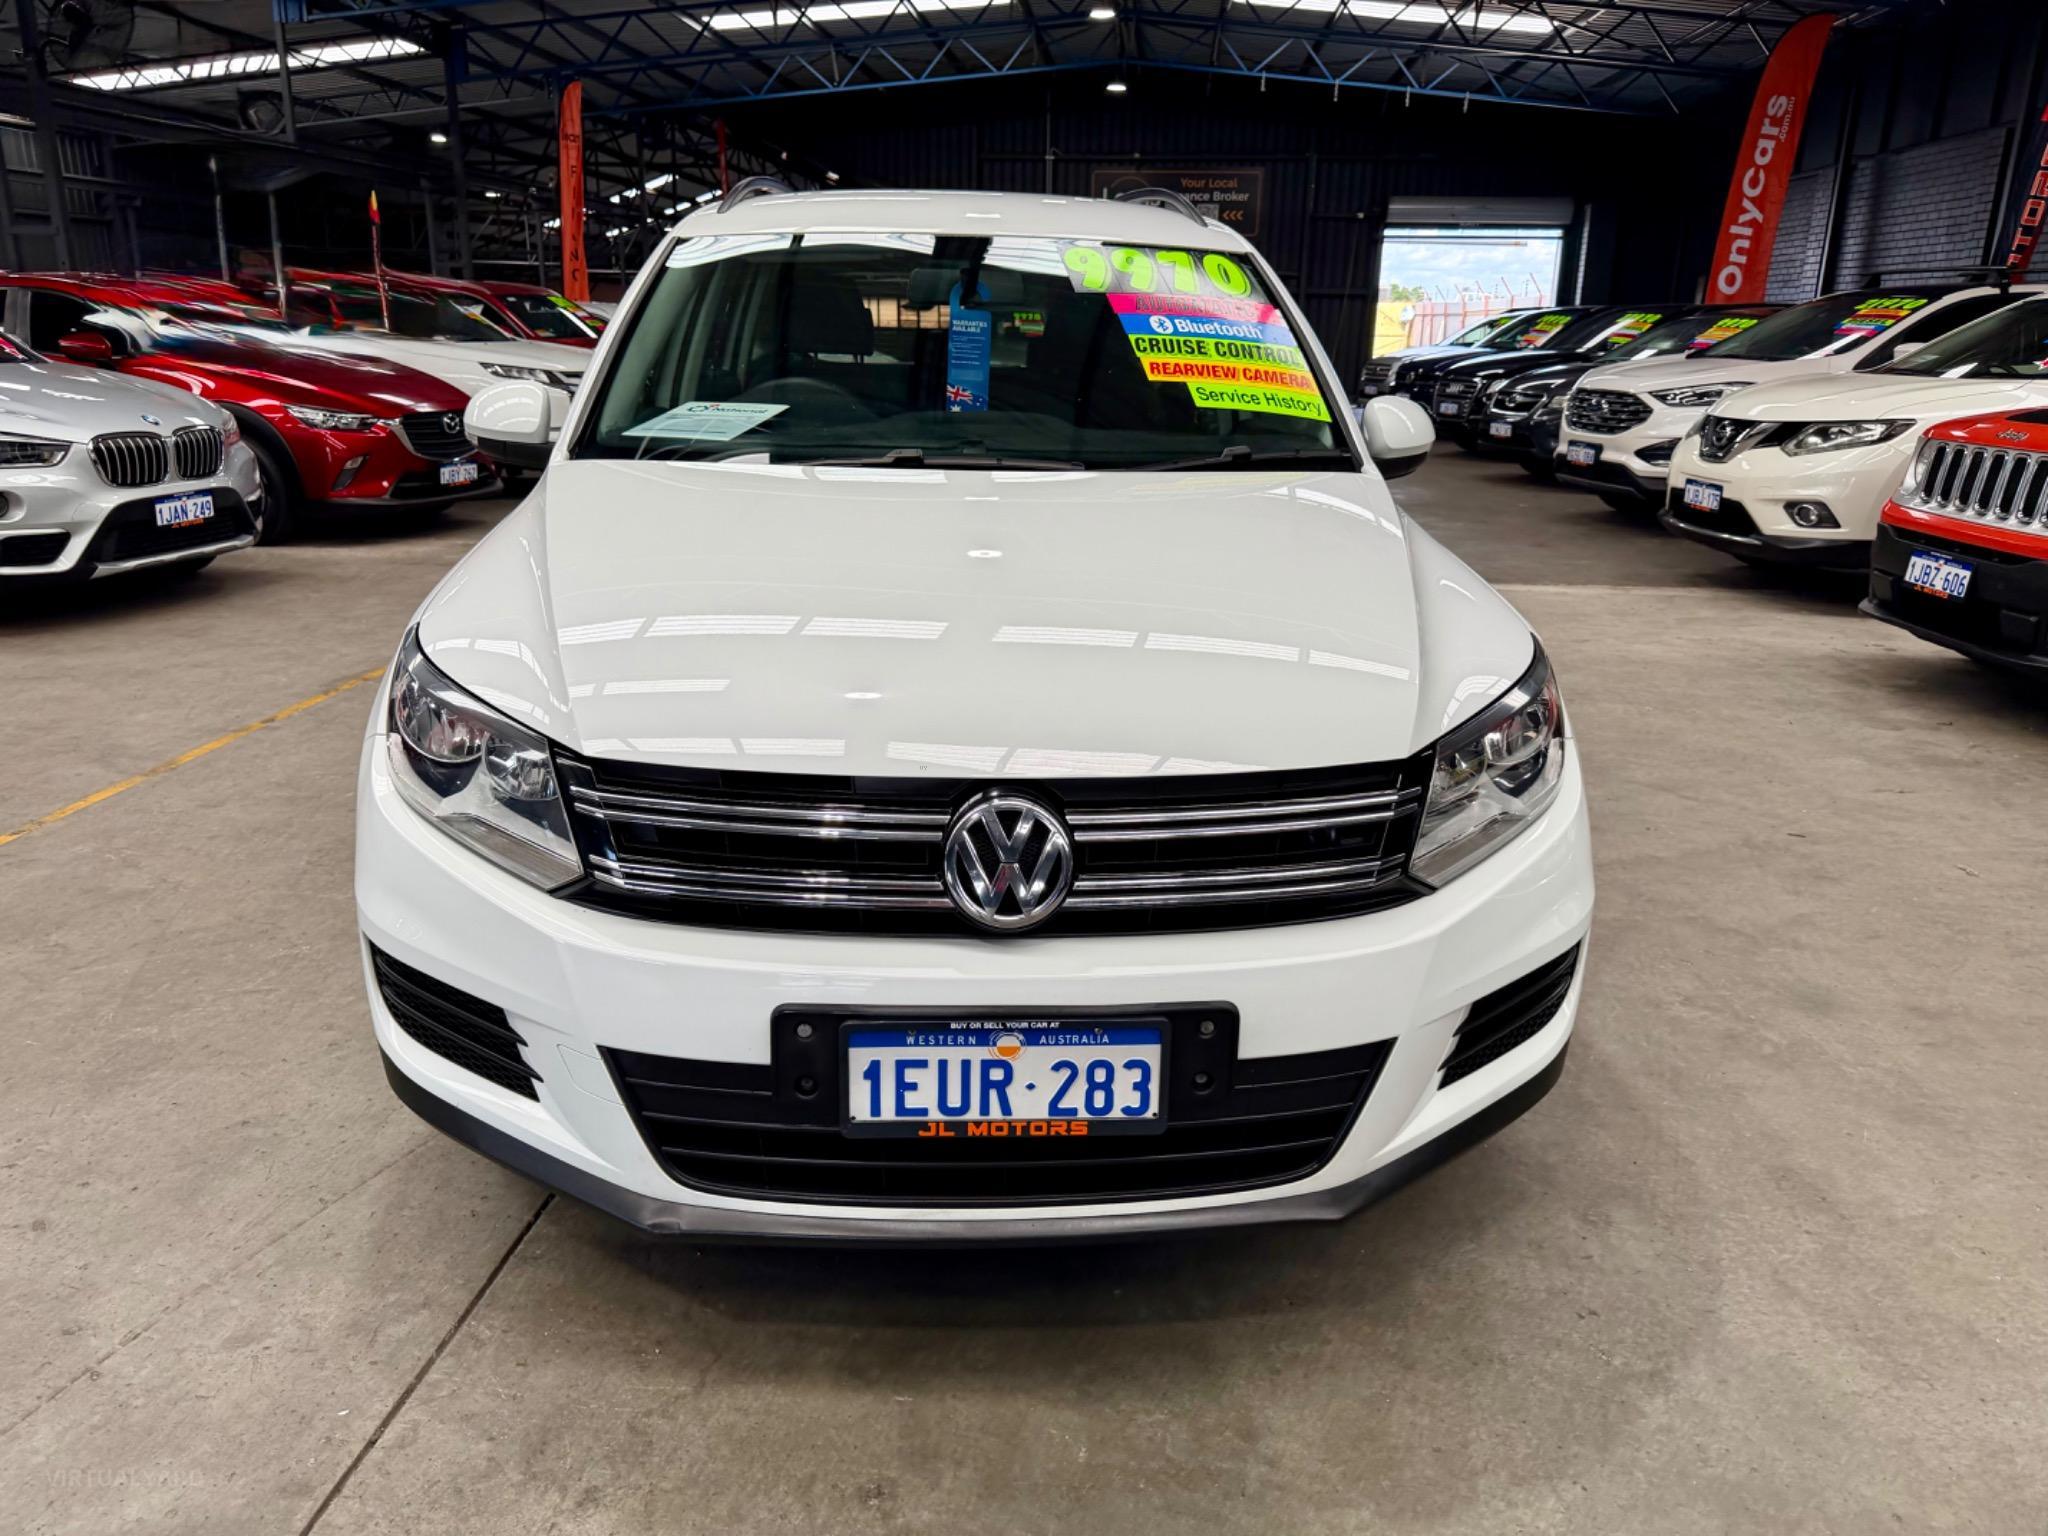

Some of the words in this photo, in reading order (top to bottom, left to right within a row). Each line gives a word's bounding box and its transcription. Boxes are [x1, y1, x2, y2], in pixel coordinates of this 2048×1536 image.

[1180, 177, 1206, 188] Your
[1209, 177, 1238, 188] Local
[1717, 94, 1788, 295] OnlyCars
[1213, 191, 1250, 201] Broker
[1064, 247, 1251, 297] 9970
[1134, 337, 1208, 356] CRUISE
[1214, 341, 1301, 367] CONTROL
[1149, 362, 1237, 379] REARVIEW
[1242, 367, 1310, 388] CAMERA
[1196, 387, 1262, 405] Service
[1264, 392, 1322, 417] History
[905, 1034, 977, 1045] WESTERN
[1039, 1033, 1110, 1045] AUSTRALIA
[918, 1122, 955, 1137] JL
[967, 1120, 1089, 1137] MOTORS
